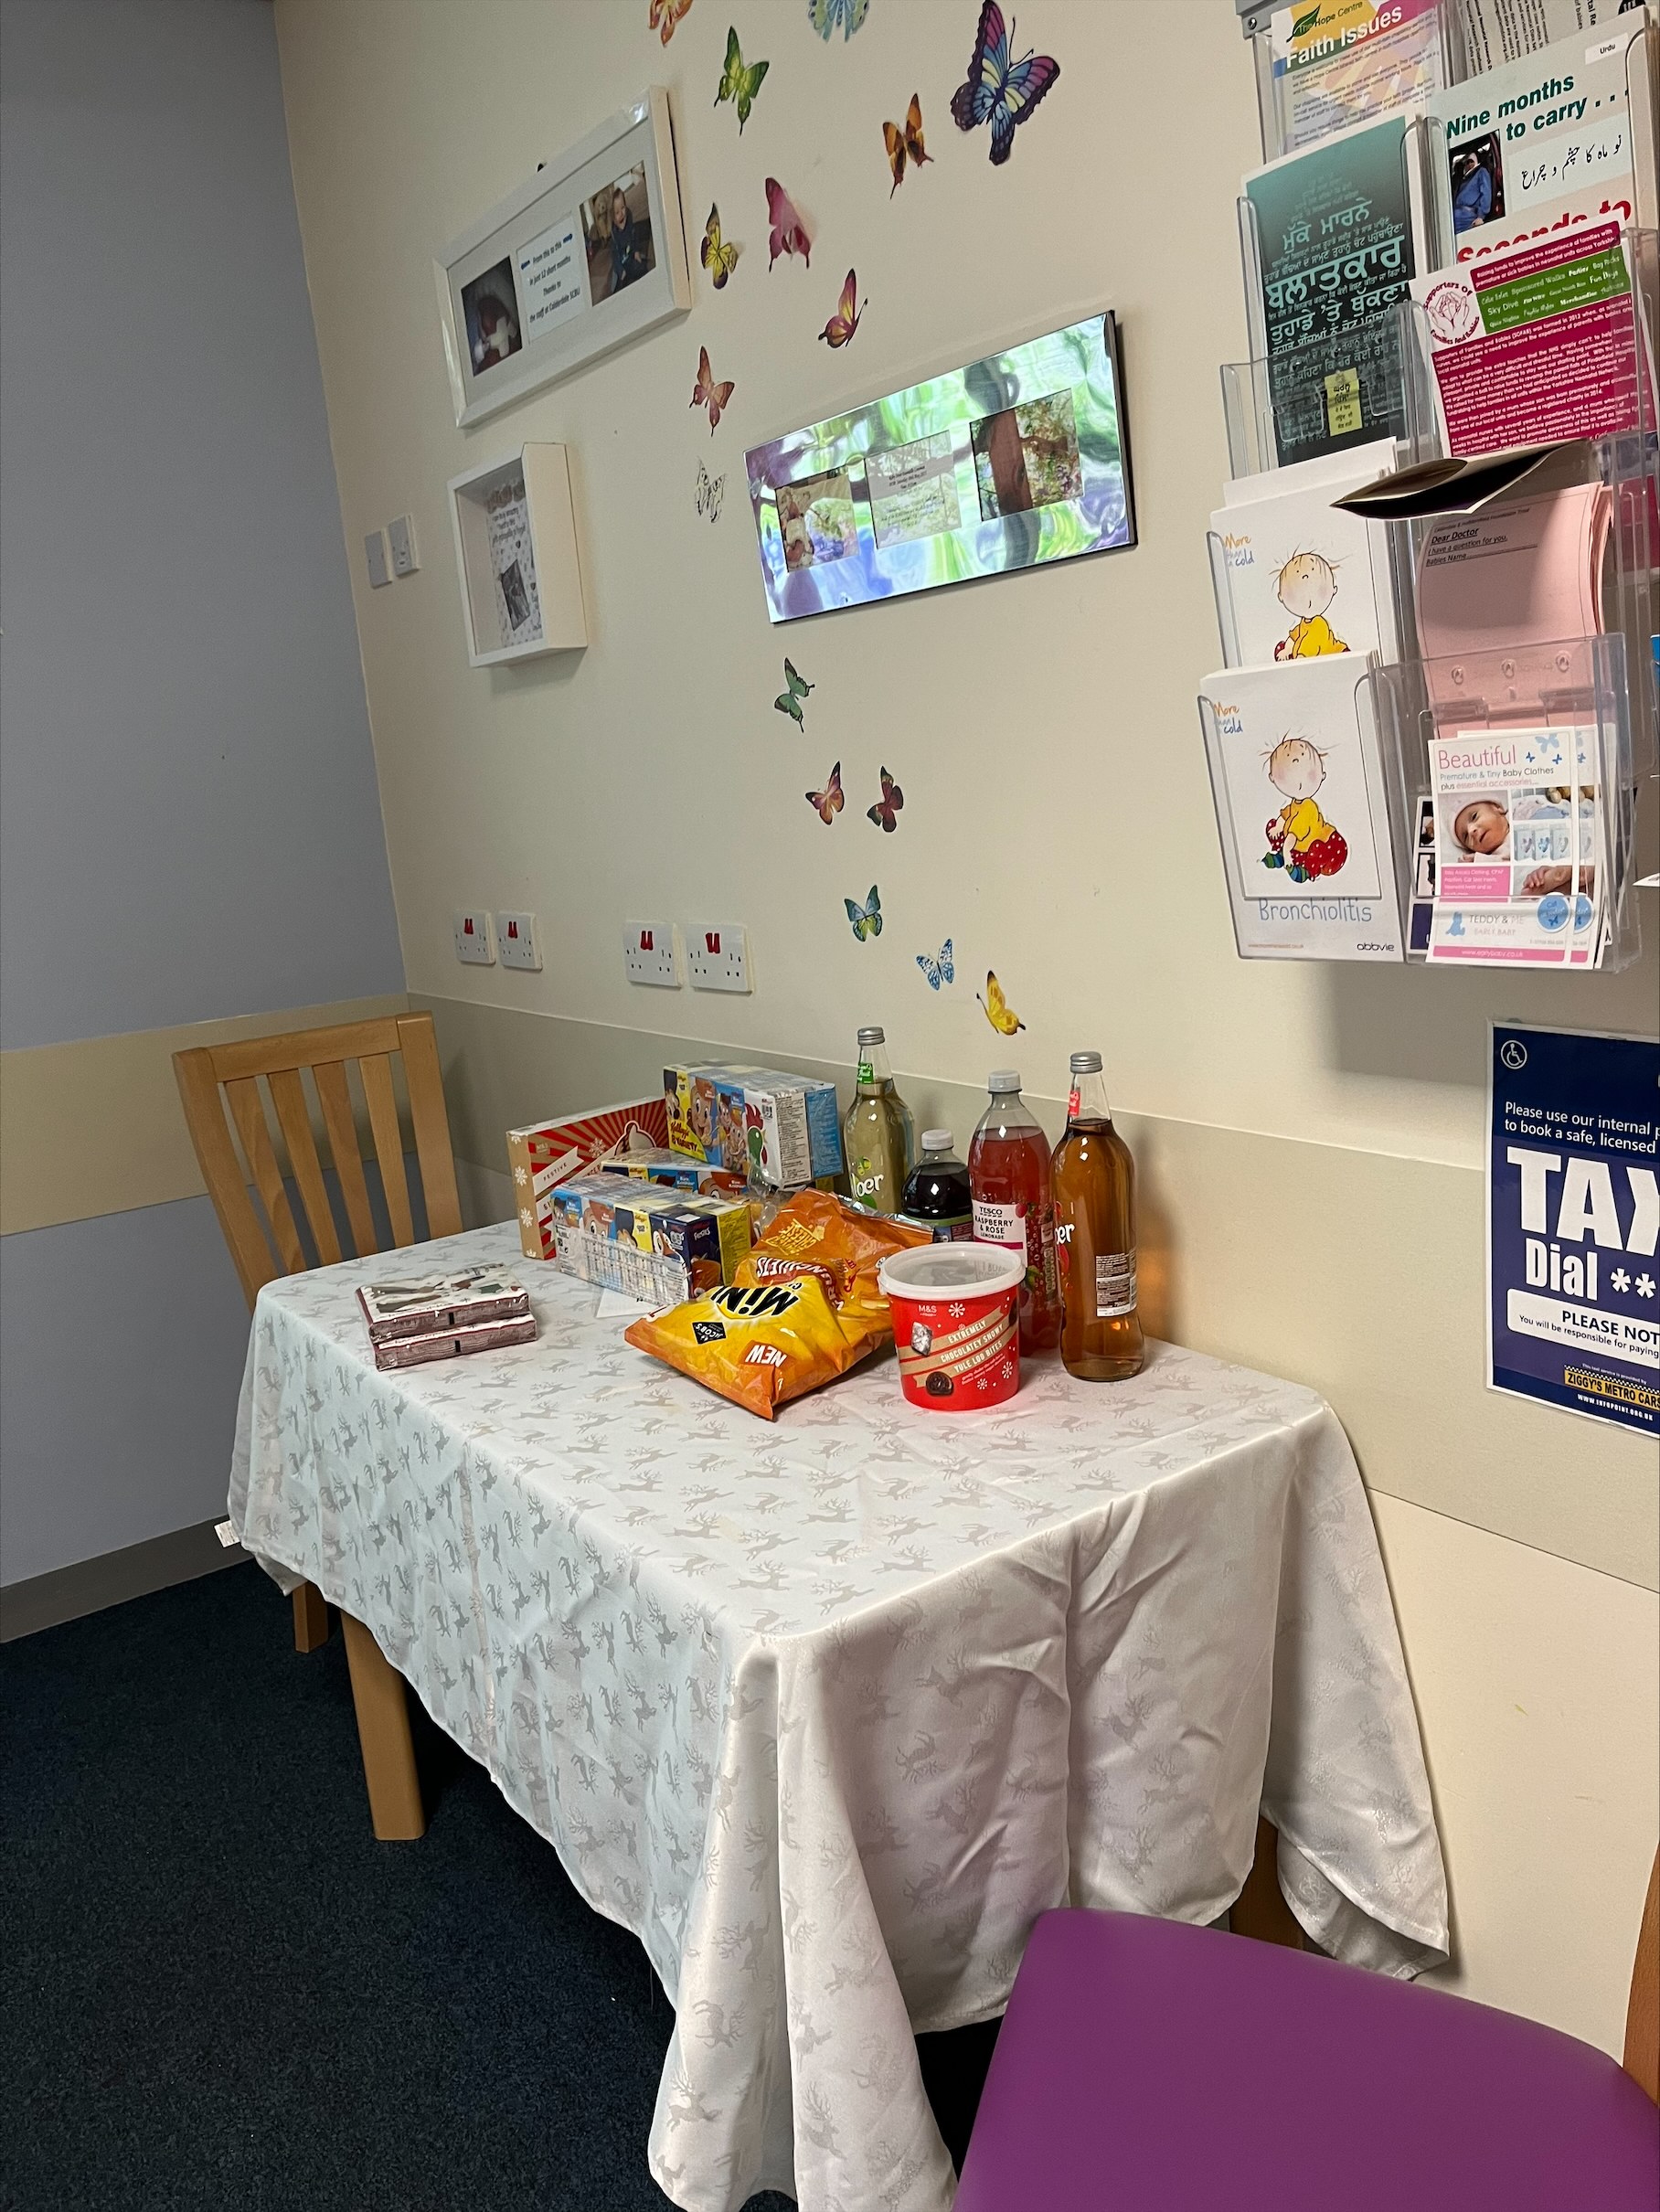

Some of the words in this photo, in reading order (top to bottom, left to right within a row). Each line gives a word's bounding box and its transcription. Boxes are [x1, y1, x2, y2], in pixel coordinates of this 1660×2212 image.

[1314, 13, 1336, 27] Hope
[1337, 2, 1363, 17] Centre
[1285, 35, 1335, 69] Faith
[1341, 5, 1401, 48] Issues
[1600, 43, 1616, 55] Urdu
[1447, 109, 1490, 139] Nine
[1498, 75, 1574, 118] months
[1506, 122, 1526, 141] to
[1534, 97, 1587, 130] carry
[1586, 144, 1595, 163] کا
[1597, 144, 1608, 159] ماہ
[1612, 134, 1622, 155] نو
[1521, 164, 1546, 189] چراغ
[1282, 220, 1311, 253] ਮੁੱਕੇ
[1320, 197, 1371, 233] ਮਾਰਨੇ
[1514, 255, 1534, 264] improve
[1544, 241, 1572, 254] experience
[1579, 233, 1600, 242] families
[1575, 244, 1592, 253] across
[1265, 235, 1405, 309] ਬਲਾਤਕਾਰ
[1487, 306, 1500, 315] Sky
[1502, 300, 1518, 310] Dive
[1589, 275, 1601, 283] Fun
[1511, 278, 1544, 294] Sponsored
[1270, 309, 1314, 344] ਤੁਹਾਡੇ
[1351, 280, 1410, 316] ਥੁੱਕਣਾ
[1224, 533, 1251, 548] More
[1431, 535, 1450, 545] Dear
[1451, 527, 1478, 540] Doctor
[1431, 547, 1446, 555] have
[1452, 539, 1480, 551] question
[1482, 537, 1492, 545] for
[1235, 550, 1255, 567] cold
[1447, 553, 1466, 562] Name
[1213, 702, 1240, 716] More
[1223, 718, 1243, 734] cold
[1438, 744, 1517, 770] Beautiful
[1440, 771, 1477, 782] Premature
[1479, 771, 1485, 779] &
[1486, 770, 1501, 781] Tiny
[1503, 768, 1523, 780] Baby
[1524, 766, 1555, 777] Clothes
[1441, 782, 1455, 792] plus
[1456, 781, 1488, 790] essential
[1259, 898, 1372, 922] Bronchiolitis
[1469, 914, 1500, 924] TEDDY
[1501, 915, 1508, 924] &
[1357, 942, 1395, 952] abbvie
[1505, 1101, 1543, 1119] Please
[1547, 1111, 1568, 1123] use
[1571, 1114, 1594, 1127] our
[1598, 1115, 1651, 1135] internal
[1505, 1119, 1517, 1132] to
[1520, 1120, 1552, 1138] book
[1555, 1129, 1563, 1139] a
[1566, 1129, 1595, 1147] safe,
[1600, 1132, 1656, 1154] licensed
[543, 1163, 568, 1181] FESTIVE
[974, 1215, 1014, 1227] RASPBERRY
[979, 1206, 1003, 1216] TESCO
[985, 1225, 1006, 1234] ROSE
[1526, 1237, 1598, 1302] Dial
[918, 1304, 937, 1313] M&S
[948, 1319, 986, 1344] EXTREMELY
[1561, 1310, 1619, 1336] PLEASE
[940, 1339, 983, 1364] CHOCOLATEY
[983, 1323, 1005, 1344] SNOWY
[1518, 1314, 1534, 1326] You
[1536, 1318, 1549, 1329] will
[1551, 1322, 1561, 1333] be
[1564, 1325, 1612, 1346] responsible
[1613, 1335, 1626, 1349] for
[1629, 1343, 1659, 1359] paying
[744, 1345, 788, 1367] NEW
[953, 1358, 972, 1373] YULE
[985, 1340, 1004, 1357] BITES
[1568, 1372, 1602, 1392] ZIGGY'S
[1604, 1381, 1636, 1401] METRO
